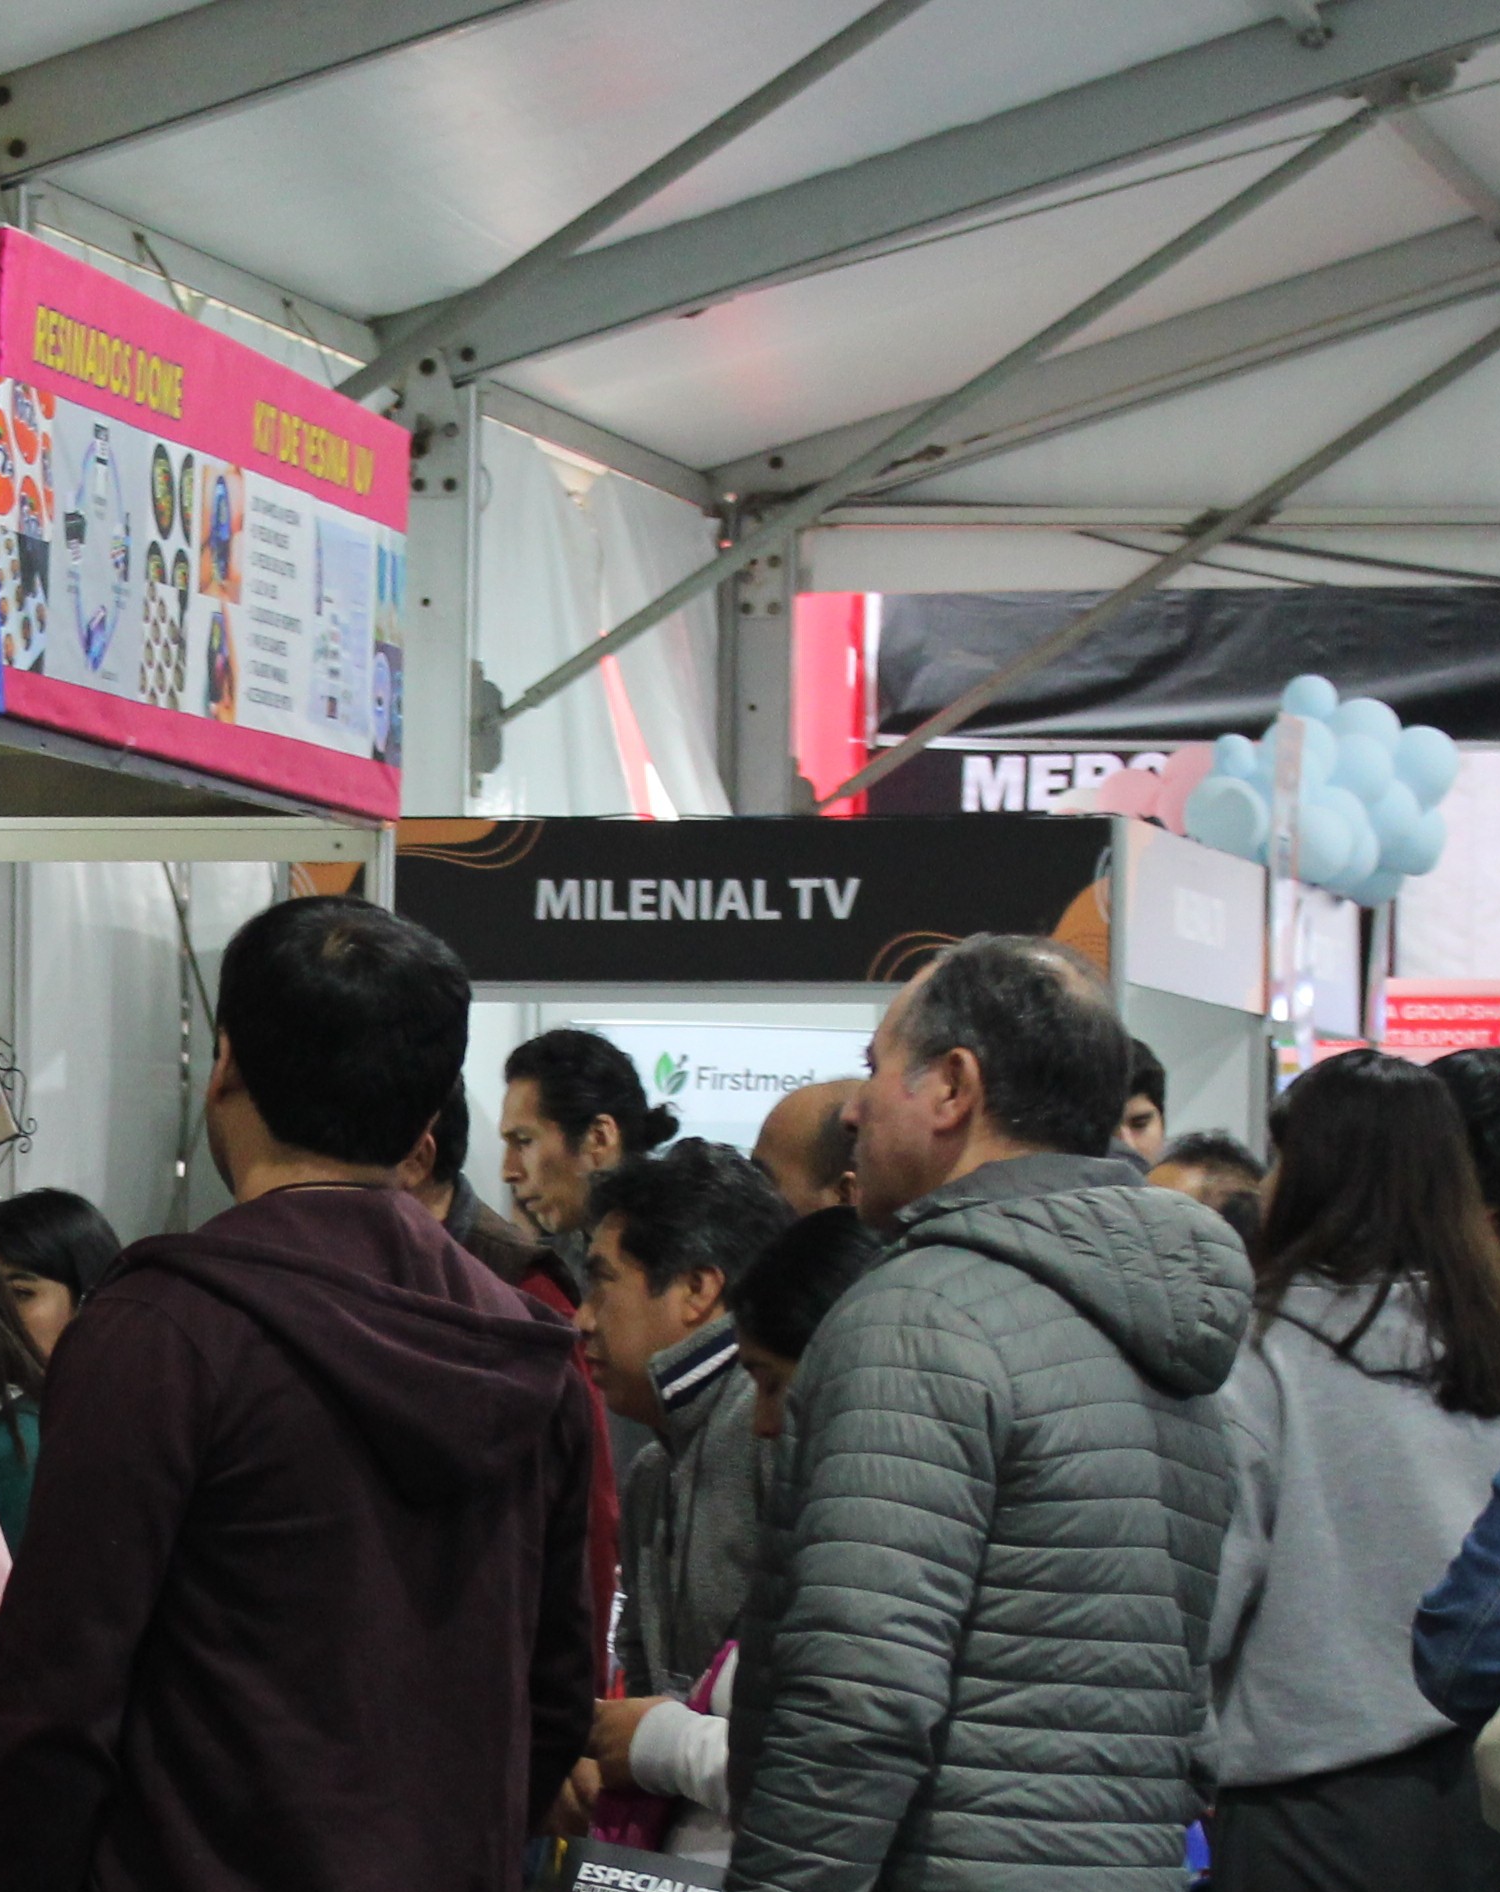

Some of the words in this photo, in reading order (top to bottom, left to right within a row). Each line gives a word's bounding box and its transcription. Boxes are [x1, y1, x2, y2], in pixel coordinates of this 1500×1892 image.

[34, 303, 133, 399] RESINADOS
[135, 348, 184, 420] DOME
[255, 400, 278, 456] KIT
[279, 410, 300, 468] DE
[534, 878, 782, 921] MILENIAL
[788, 878, 861, 920] TV
[696, 1063, 815, 1093] Firstmed
